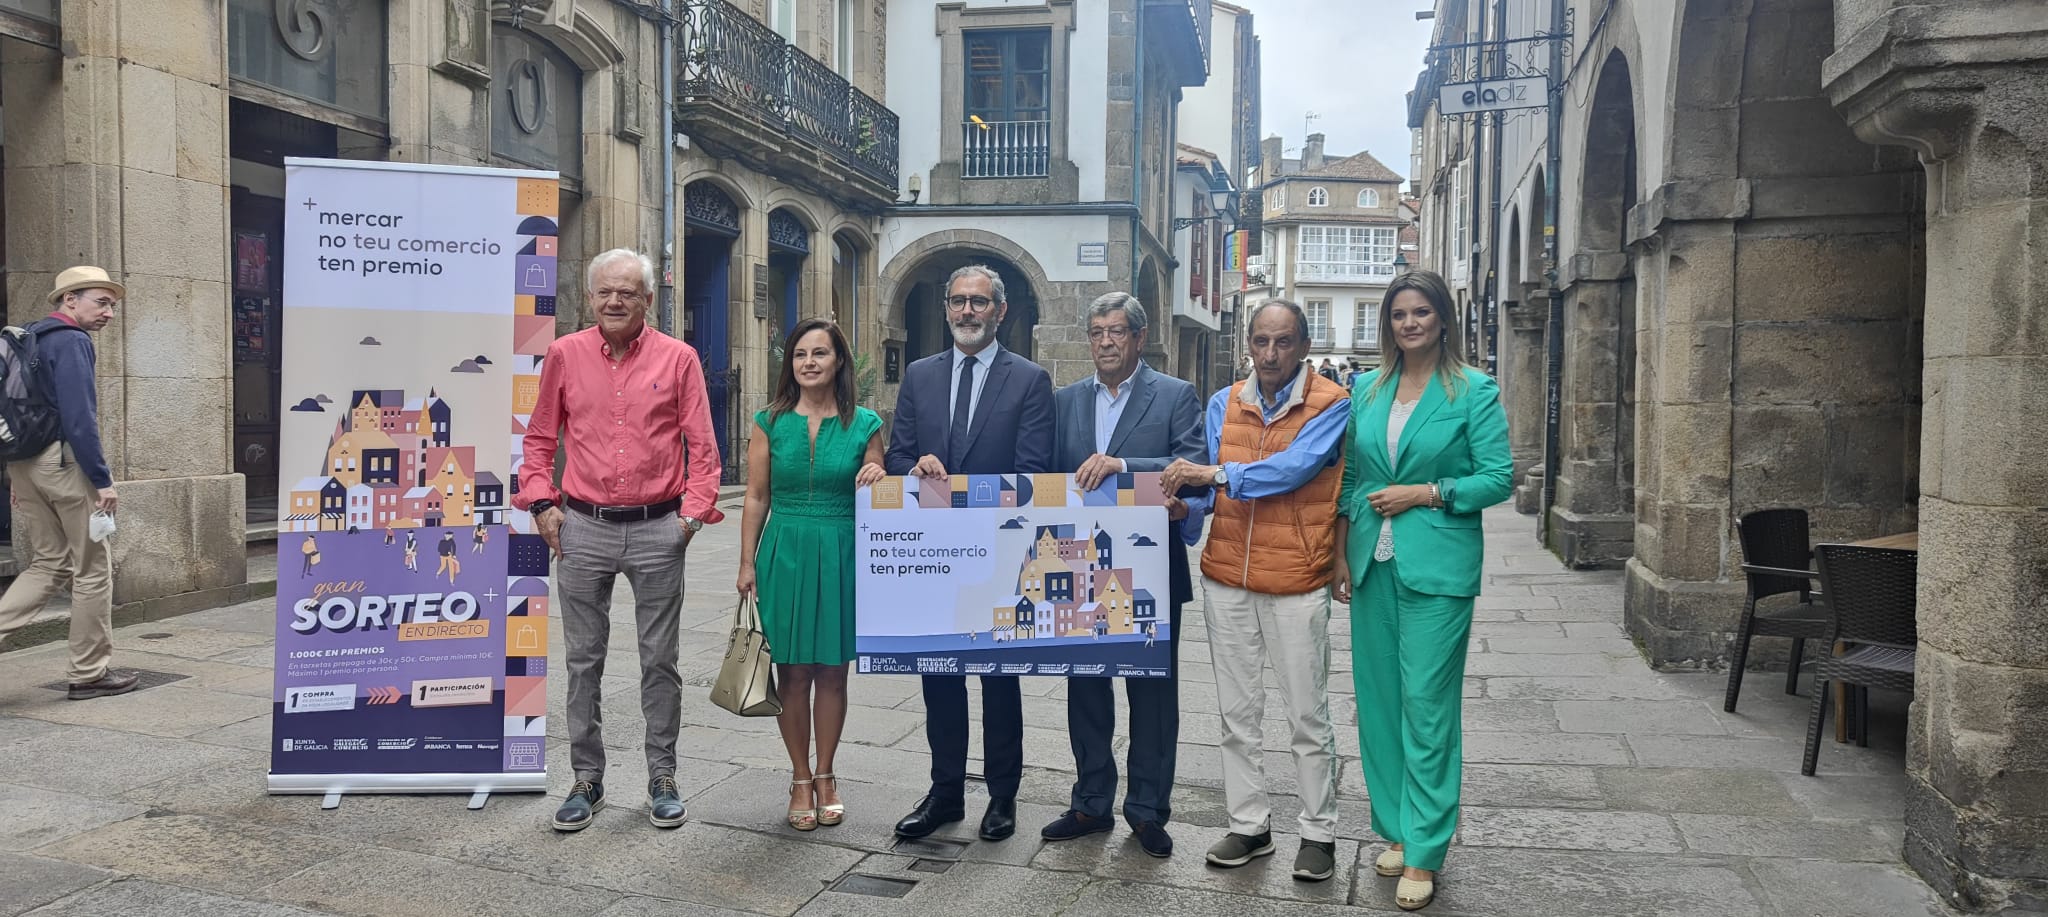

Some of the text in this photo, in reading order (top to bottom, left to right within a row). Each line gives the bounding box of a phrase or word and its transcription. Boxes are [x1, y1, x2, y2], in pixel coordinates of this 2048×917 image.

[319, 212, 403, 227] mercar
[319, 233, 501, 255] no teu comercio
[318, 255, 443, 277] ten premio
[870, 532, 924, 541] mercar
[870, 545, 987, 557] no teu comercio
[870, 562, 951, 577] ten premio
[308, 579, 368, 604] gran
[290, 591, 478, 633] SORTEO
[405, 624, 484, 638] EN DIRECTO
[325, 649, 339, 657] EN
[340, 646, 385, 656] PREMIOS
[287, 662, 299, 670] En
[366, 658, 377, 666] de
[418, 654, 449, 664] Compra
[872, 664, 912, 672] DE GALICIA
[324, 667, 353, 677] premio
[353, 666, 366, 675] por
[290, 692, 299, 708] 1
[302, 690, 335, 698] COMPRA
[419, 685, 427, 701] 1
[430, 683, 485, 692] PARTICIPACIÓN
